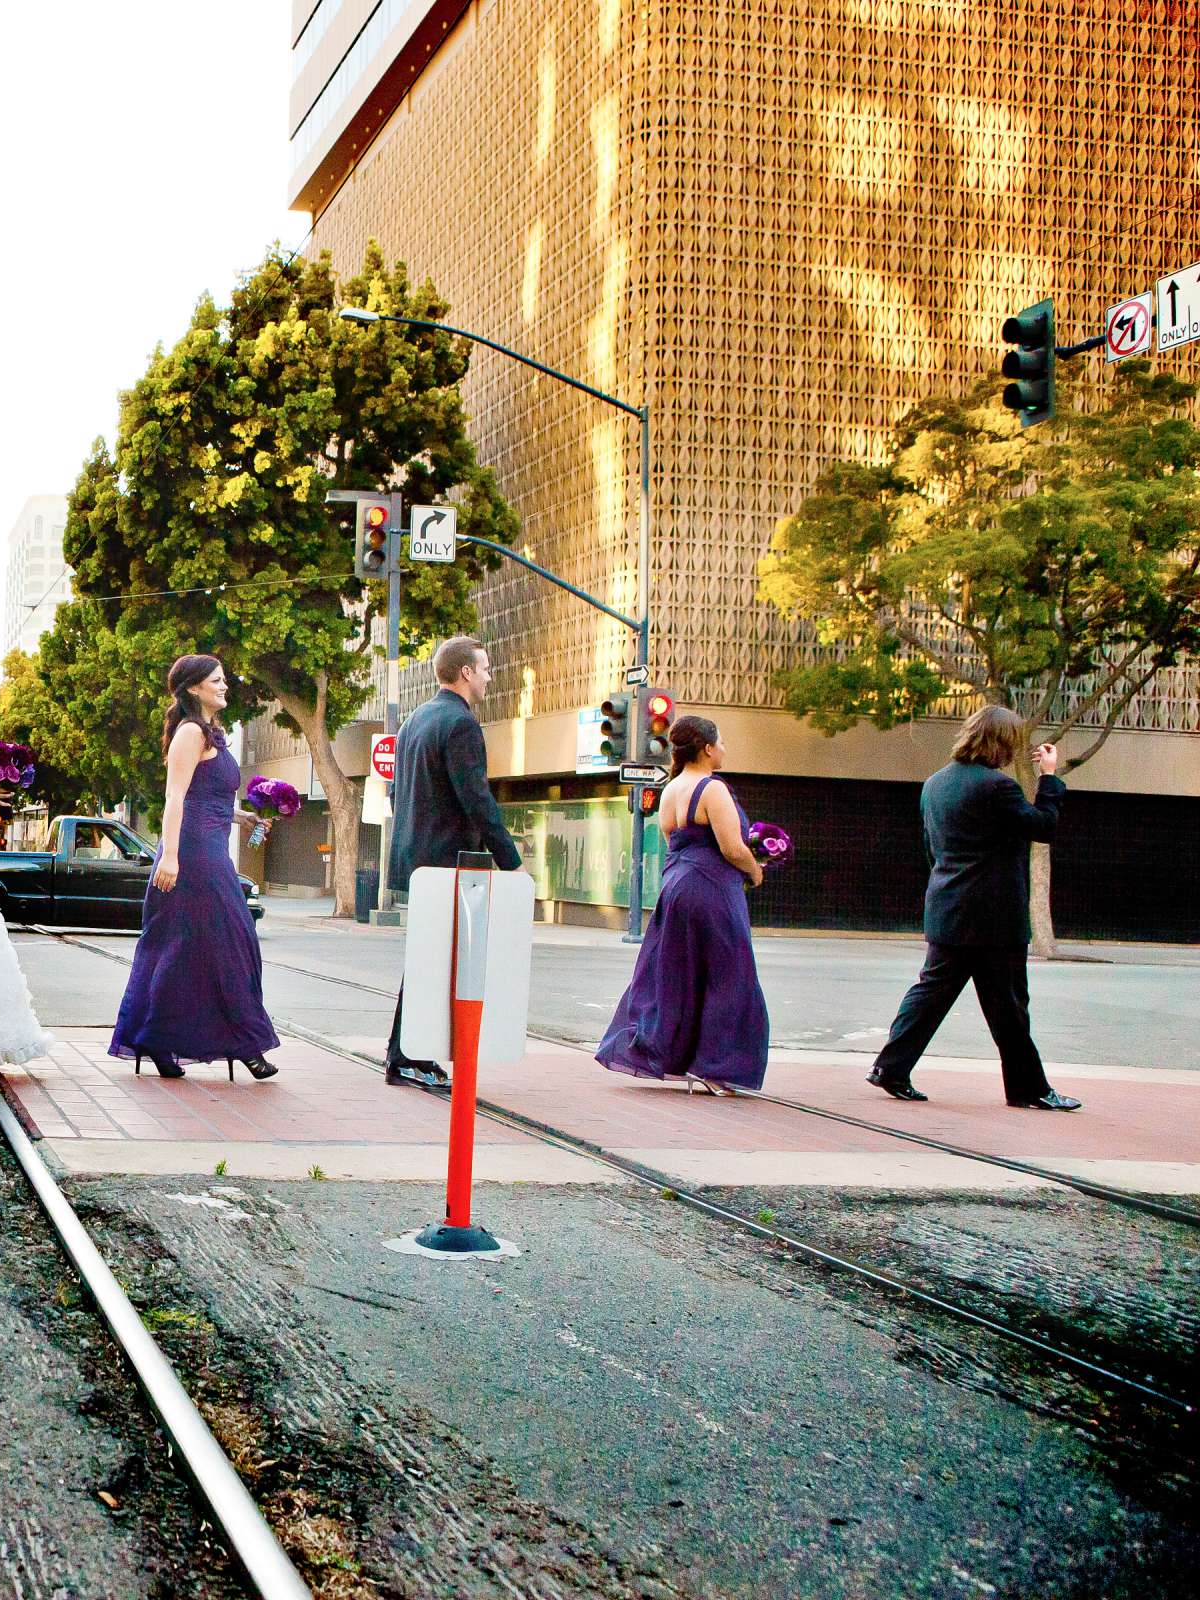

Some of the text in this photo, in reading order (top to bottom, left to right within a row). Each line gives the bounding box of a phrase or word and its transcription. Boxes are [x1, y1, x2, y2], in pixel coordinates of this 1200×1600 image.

[1161, 326, 1187, 344] ONLY
[414, 541, 453, 556] ONLY
[378, 743, 390, 752] DO
[379, 763, 395, 772] ENT
